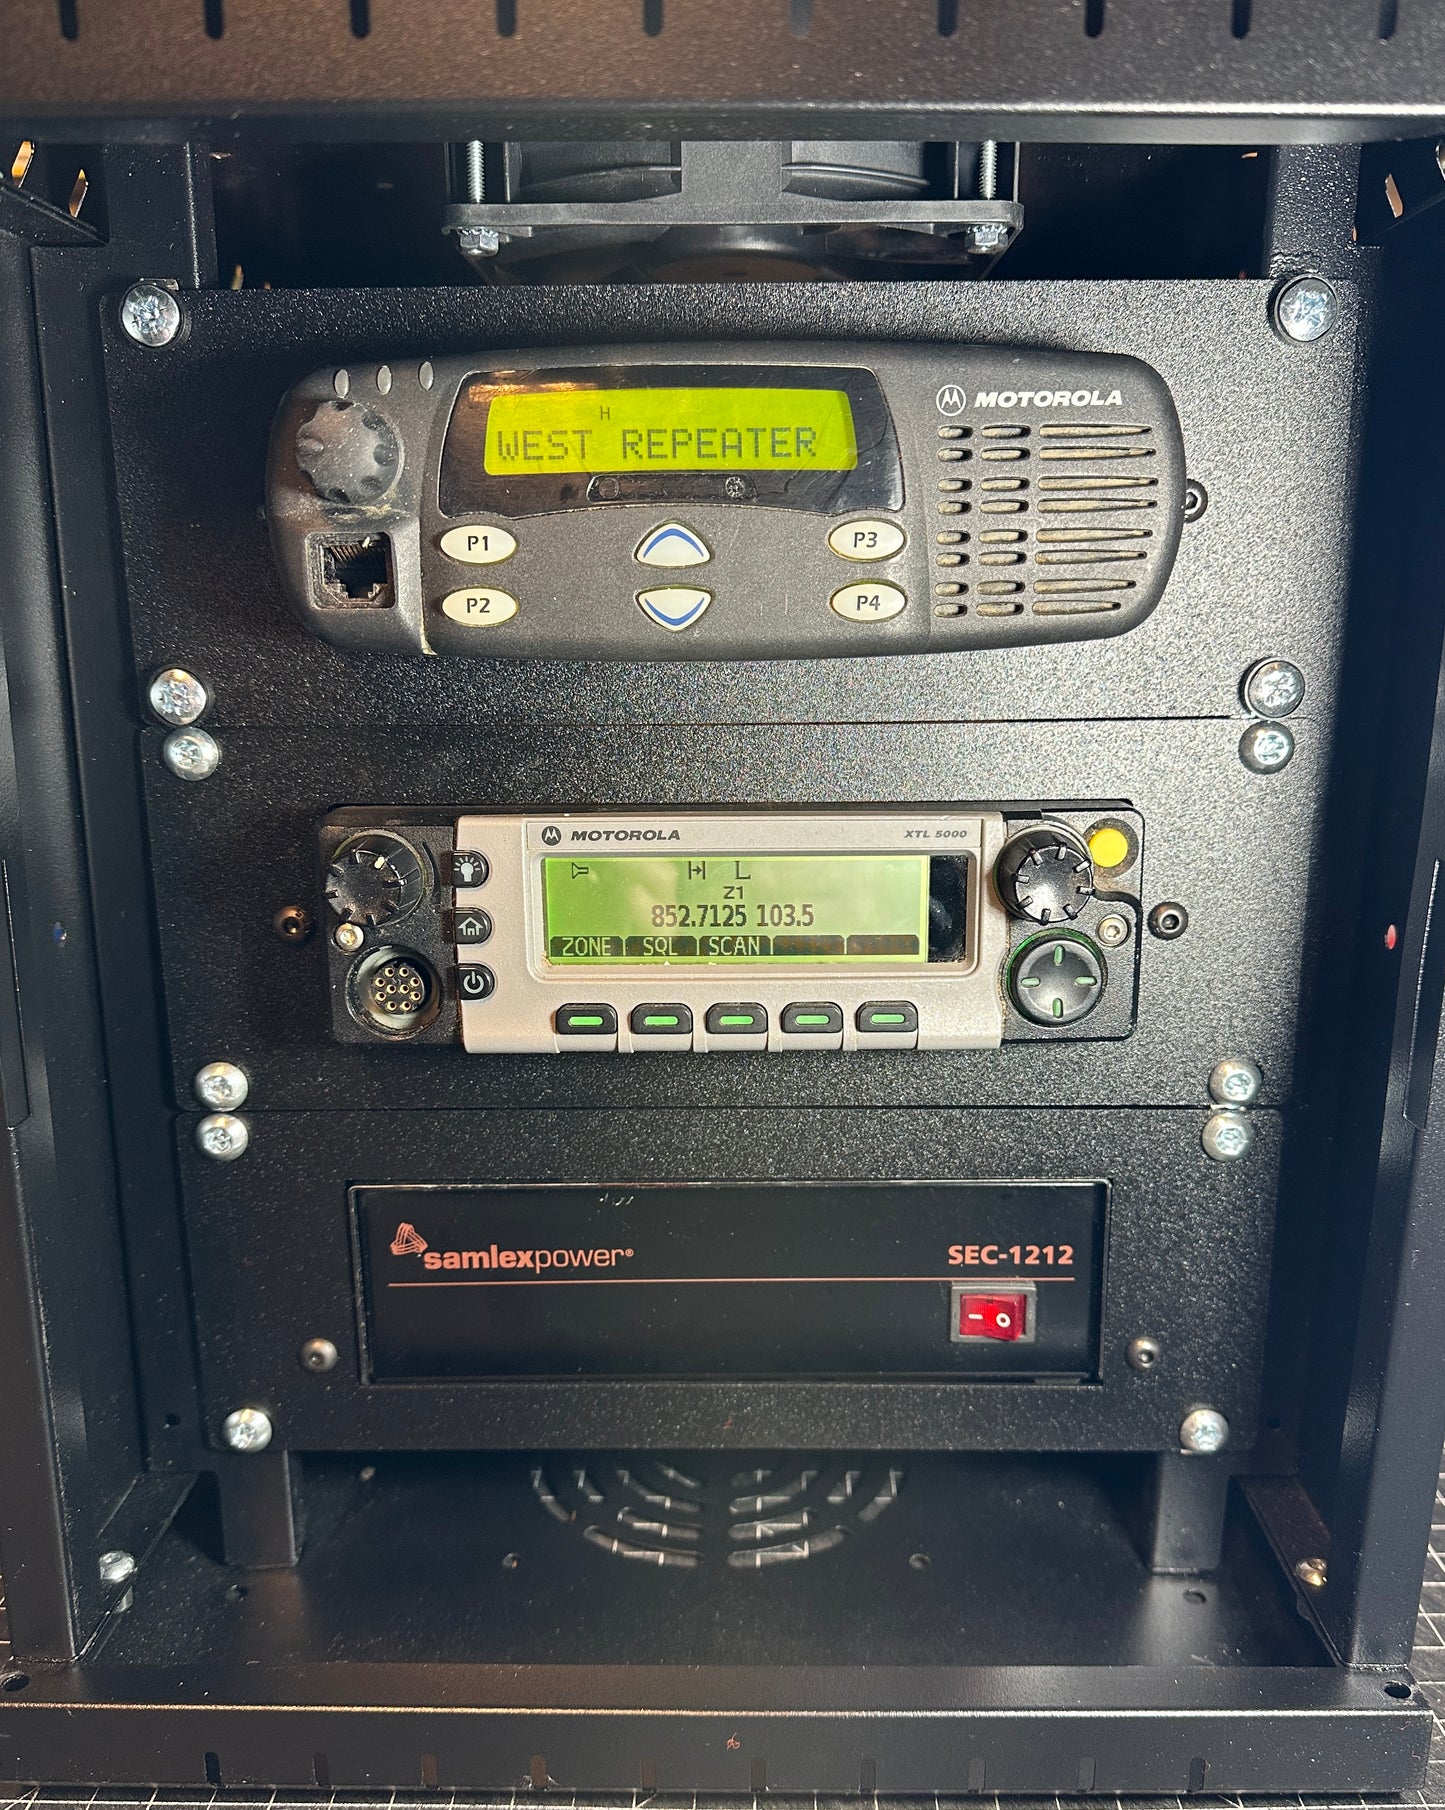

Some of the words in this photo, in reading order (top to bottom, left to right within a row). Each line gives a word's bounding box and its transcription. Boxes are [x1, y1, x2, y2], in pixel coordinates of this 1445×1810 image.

[973, 389, 1123, 408] MOTOROLA
[599, 405, 611, 421] H
[497, 429, 593, 461] WEST
[621, 426, 818, 460] REPEATER
[466, 535, 489, 552] P1
[853, 531, 878, 548] P3
[466, 597, 491, 614] P2
[855, 594, 881, 611] P4
[570, 829, 681, 842] MOTOROLA
[904, 829, 932, 839] XTL
[934, 829, 968, 839] 5000
[722, 885, 745, 900] Z1
[651, 903, 748, 928] 852.7125
[756, 903, 814, 927] 103.5
[561, 937, 612, 957] ZONE
[643, 937, 678, 957] SQL
[708, 936, 761, 955] SCAN
[948, 1244, 1073, 1265] SEC-1212
